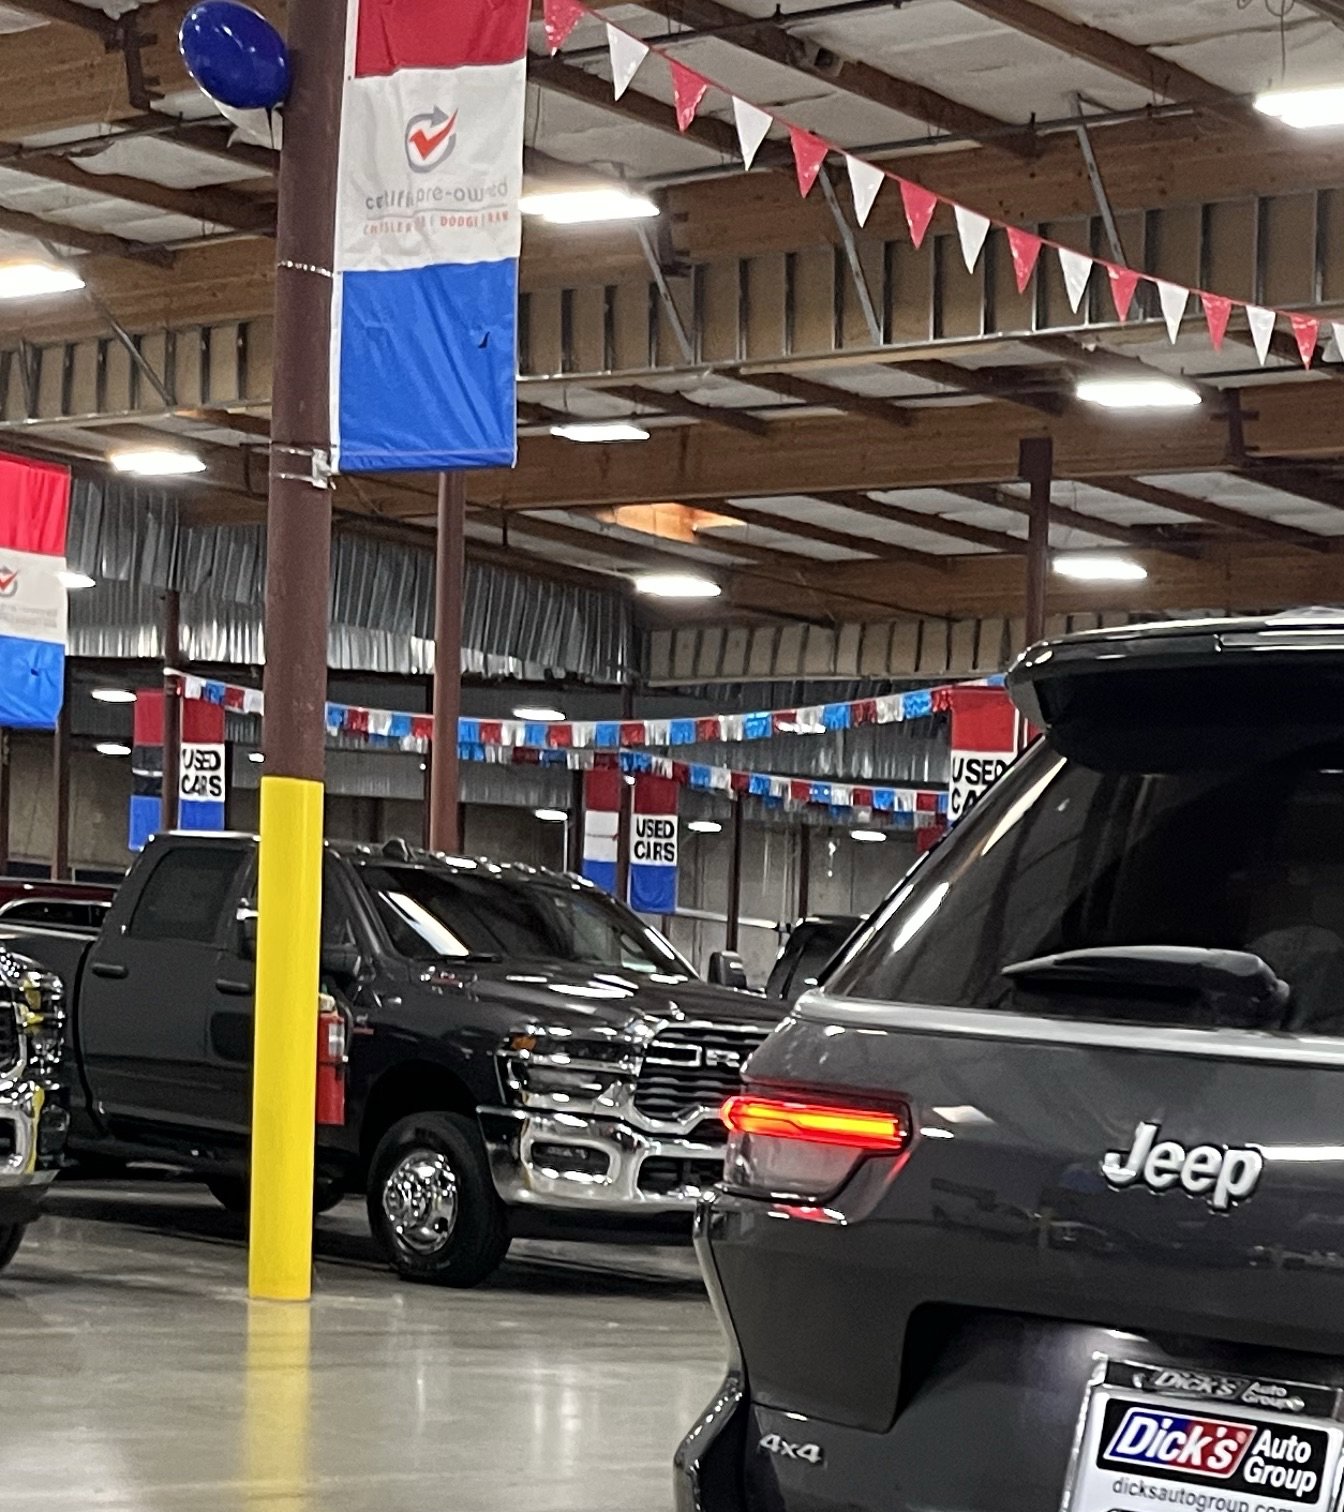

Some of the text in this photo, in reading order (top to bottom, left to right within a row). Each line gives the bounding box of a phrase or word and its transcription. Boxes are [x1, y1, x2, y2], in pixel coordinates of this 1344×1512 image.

[182, 748, 222, 771] USED
[636, 817, 675, 839] USED
[1101, 1121, 1263, 1209] Jeep
[760, 1433, 821, 1463] 4x4
[1116, 1416, 1312, 1470] Dick's Auto
[1243, 1456, 1318, 1497] Group
